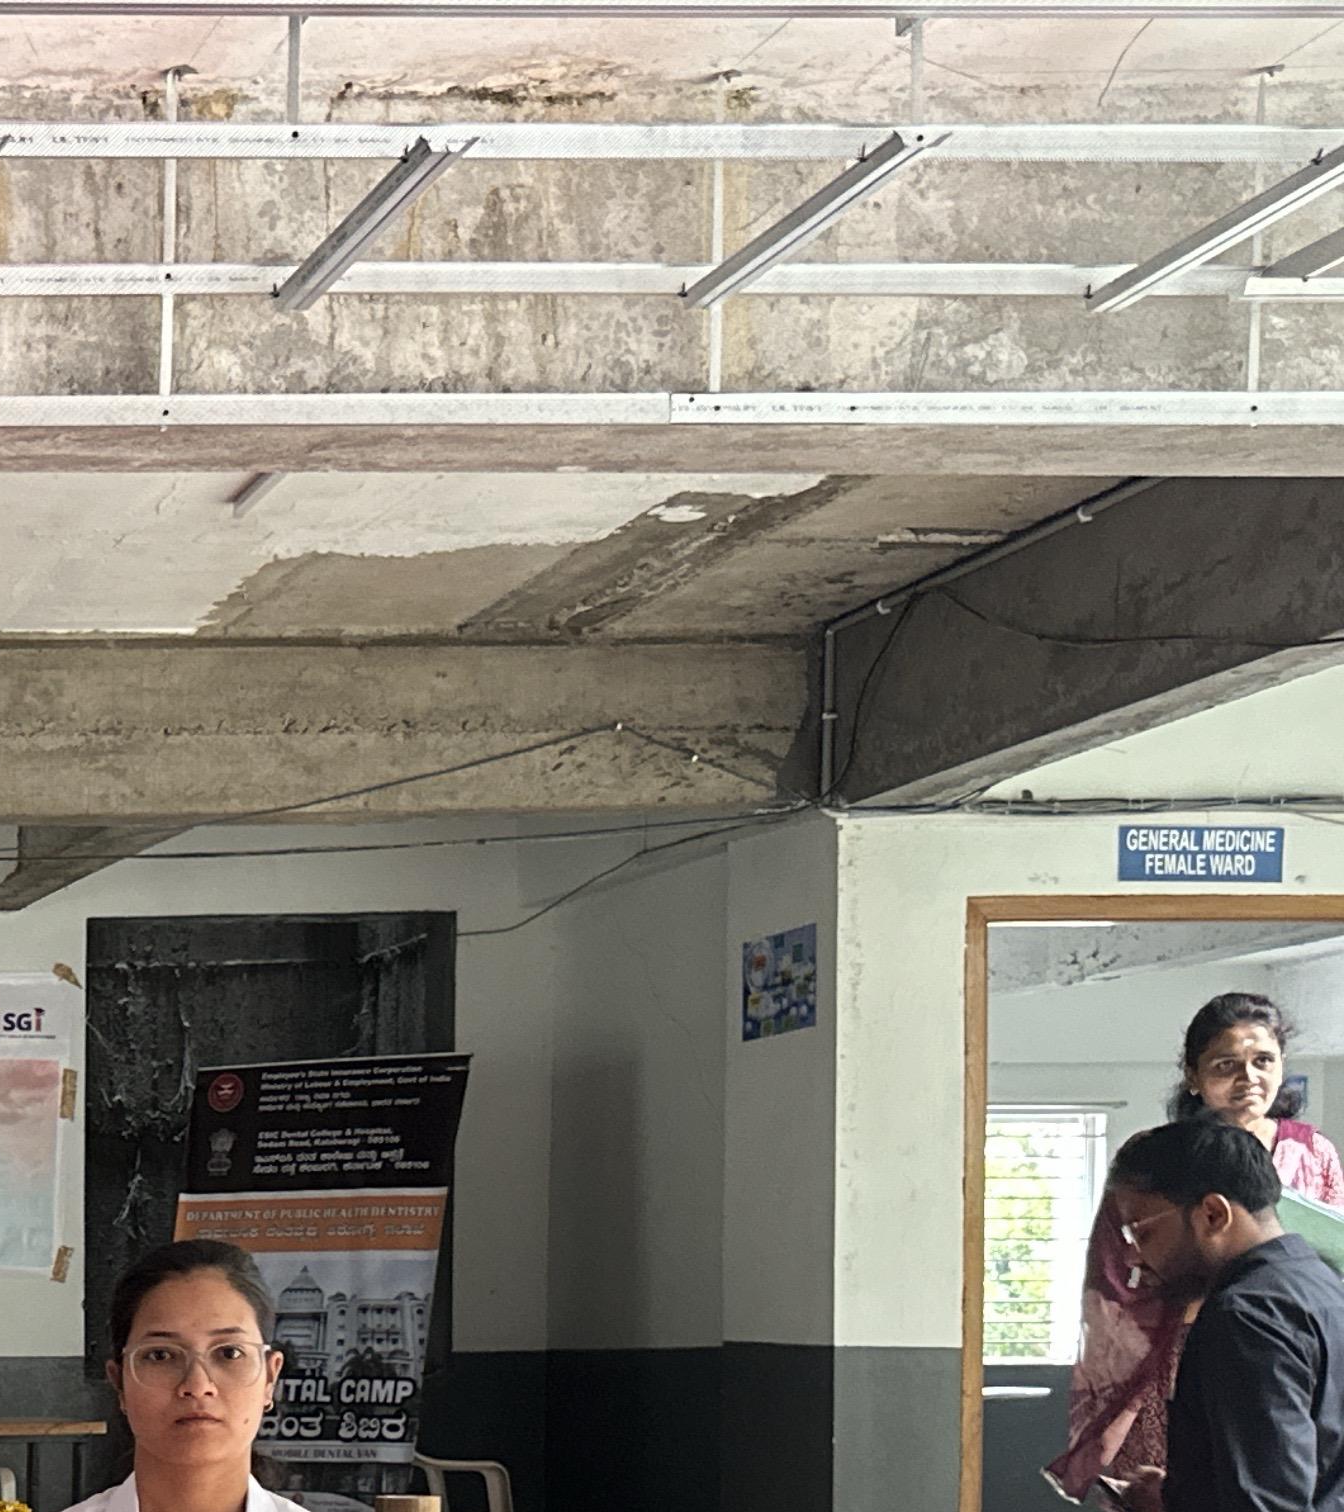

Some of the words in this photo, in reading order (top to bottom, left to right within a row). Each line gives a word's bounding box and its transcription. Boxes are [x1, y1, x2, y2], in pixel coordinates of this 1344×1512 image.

[1126, 829, 1199, 851] GENERAL
[1203, 830, 1276, 852] MEDICINE
[1145, 854, 1207, 875] FEMALE
[1210, 855, 1256, 876] WARD
[187, 1209, 261, 1222] DEPARTMENT
[263, 1208, 277, 1221] OF
[280, 1207, 322, 1219] PUBLIC
[323, 1207, 370, 1219] HEALTH
[371, 1205, 440, 1217] DENTISTRY
[340, 1378, 415, 1404] CAMP
[258, 1411, 323, 1438] ದಂತ
[338, 1411, 407, 1439] ಶಿಬಿರ
